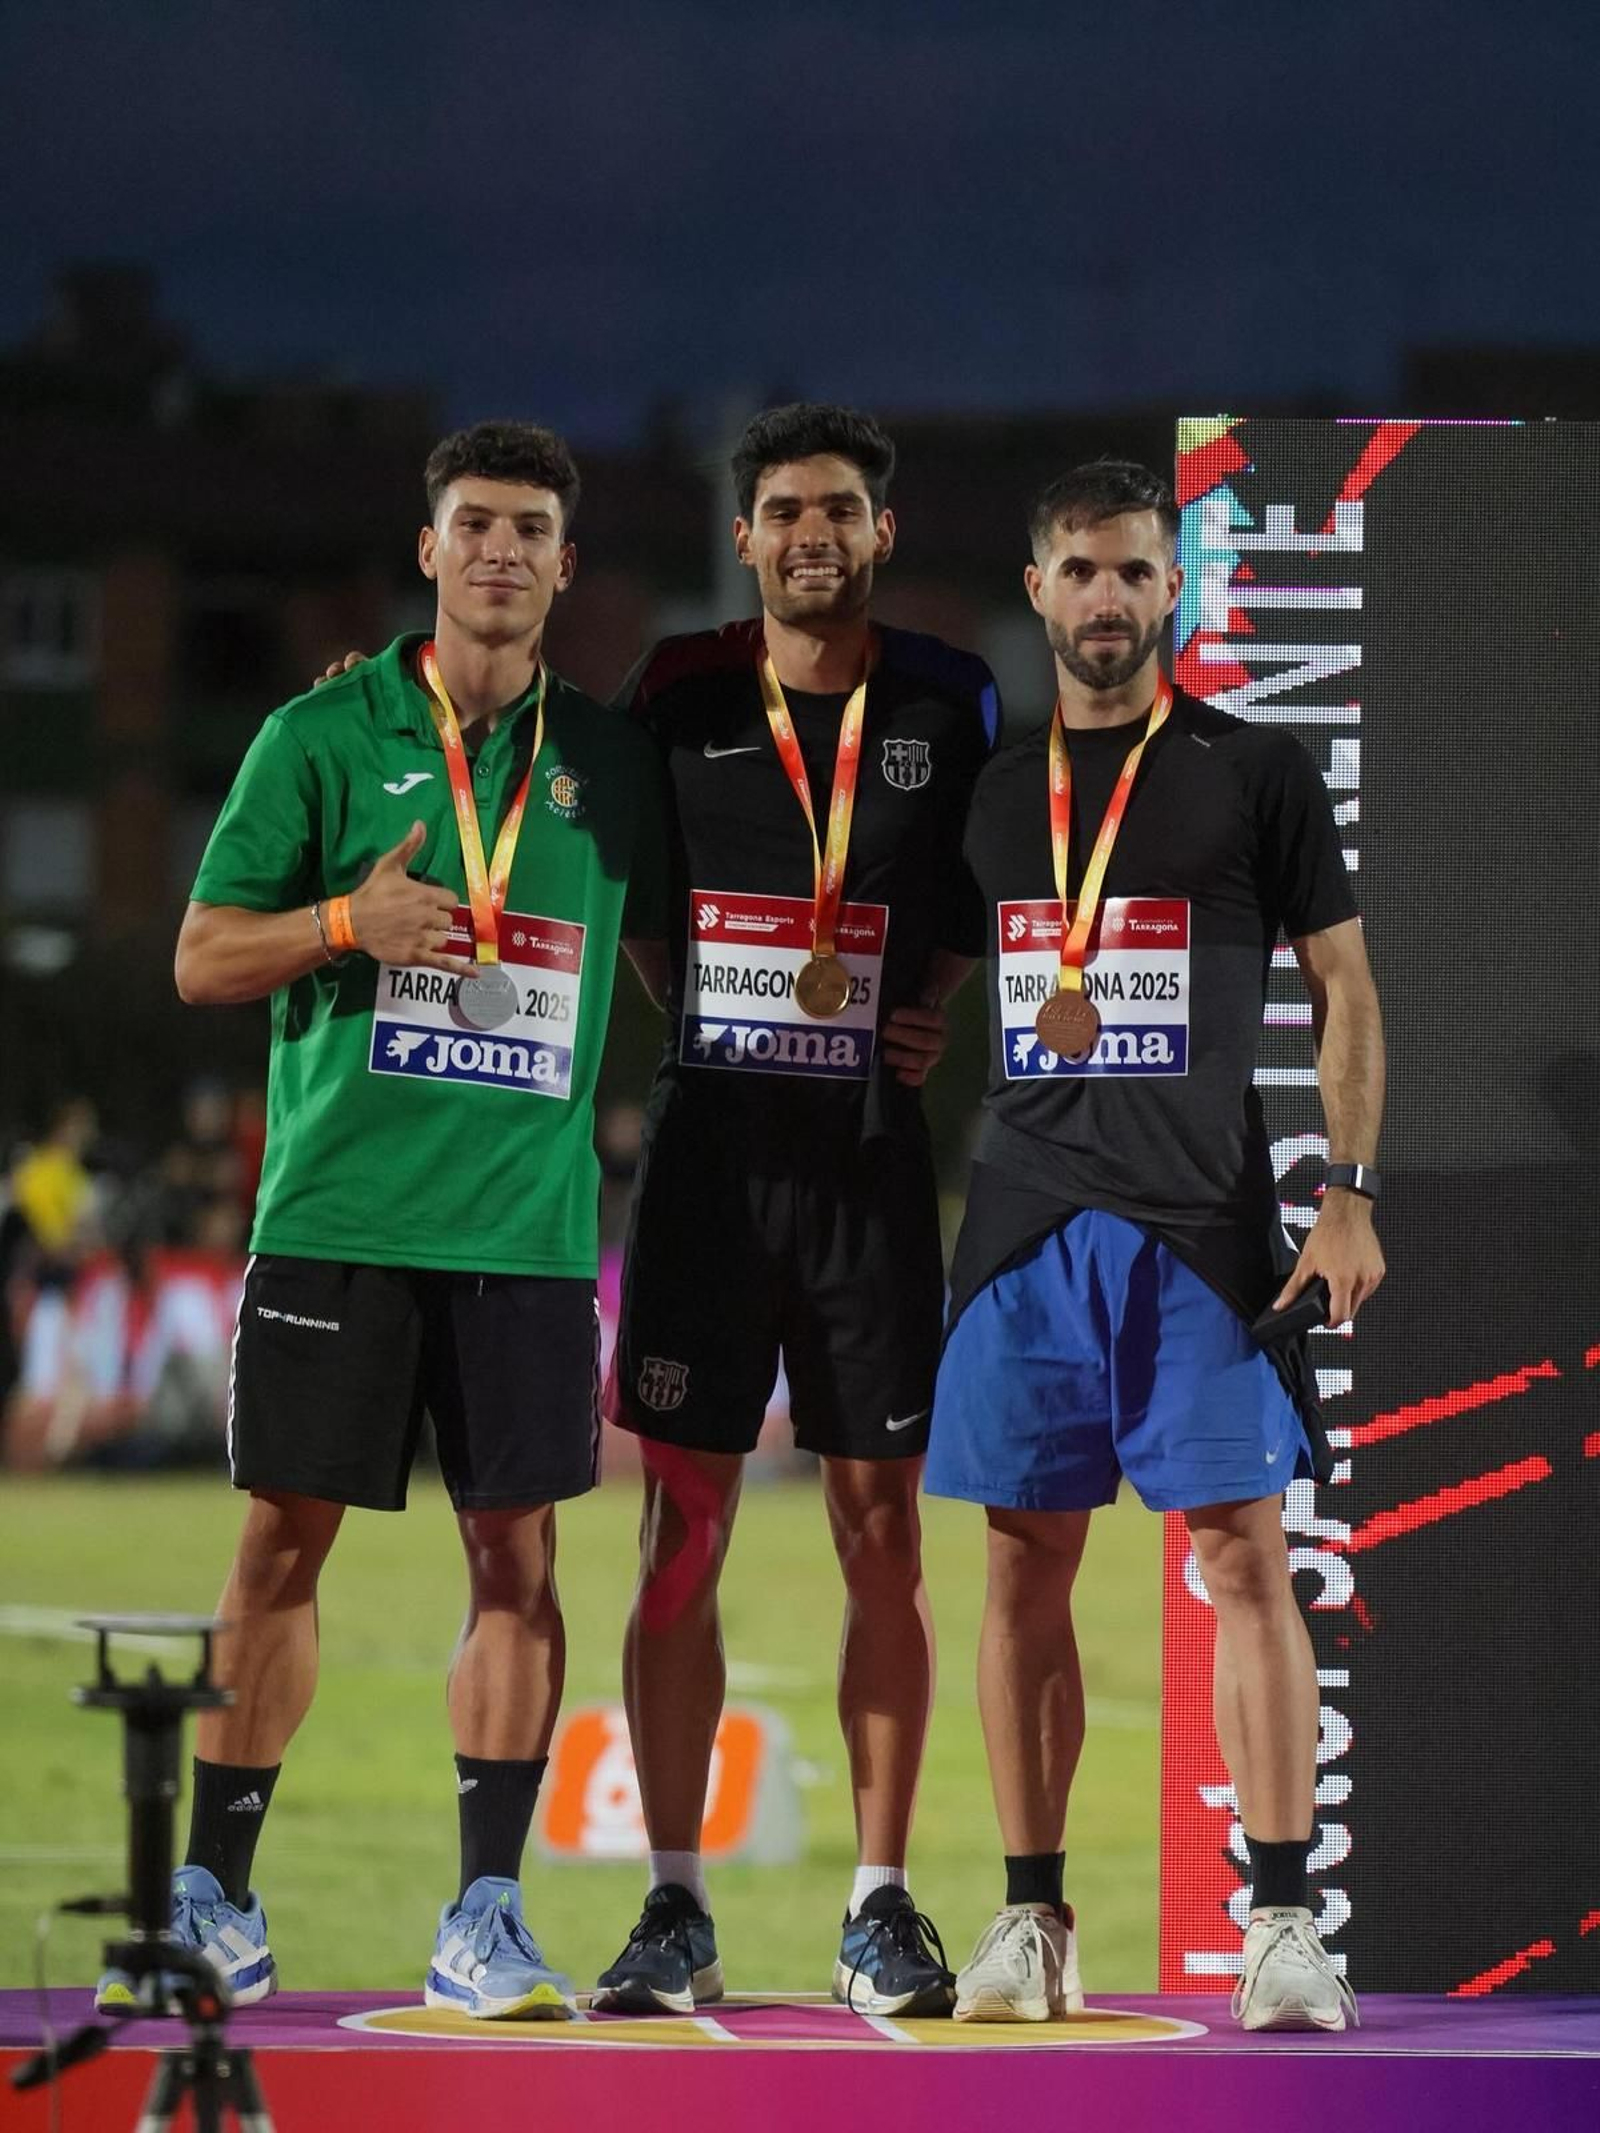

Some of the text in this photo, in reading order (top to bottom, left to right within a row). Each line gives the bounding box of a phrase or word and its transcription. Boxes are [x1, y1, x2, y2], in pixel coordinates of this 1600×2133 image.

[725, 911, 763, 923] Tarragona
[693, 962, 872, 1005] TARRAGON 25
[1005, 972, 1180, 1004] TARRAONA 2025
[524, 988, 569, 1022] 2025
[1039, 1031, 1175, 1071] Jma
[257, 1306, 340, 1331] TOP4RUNNING
